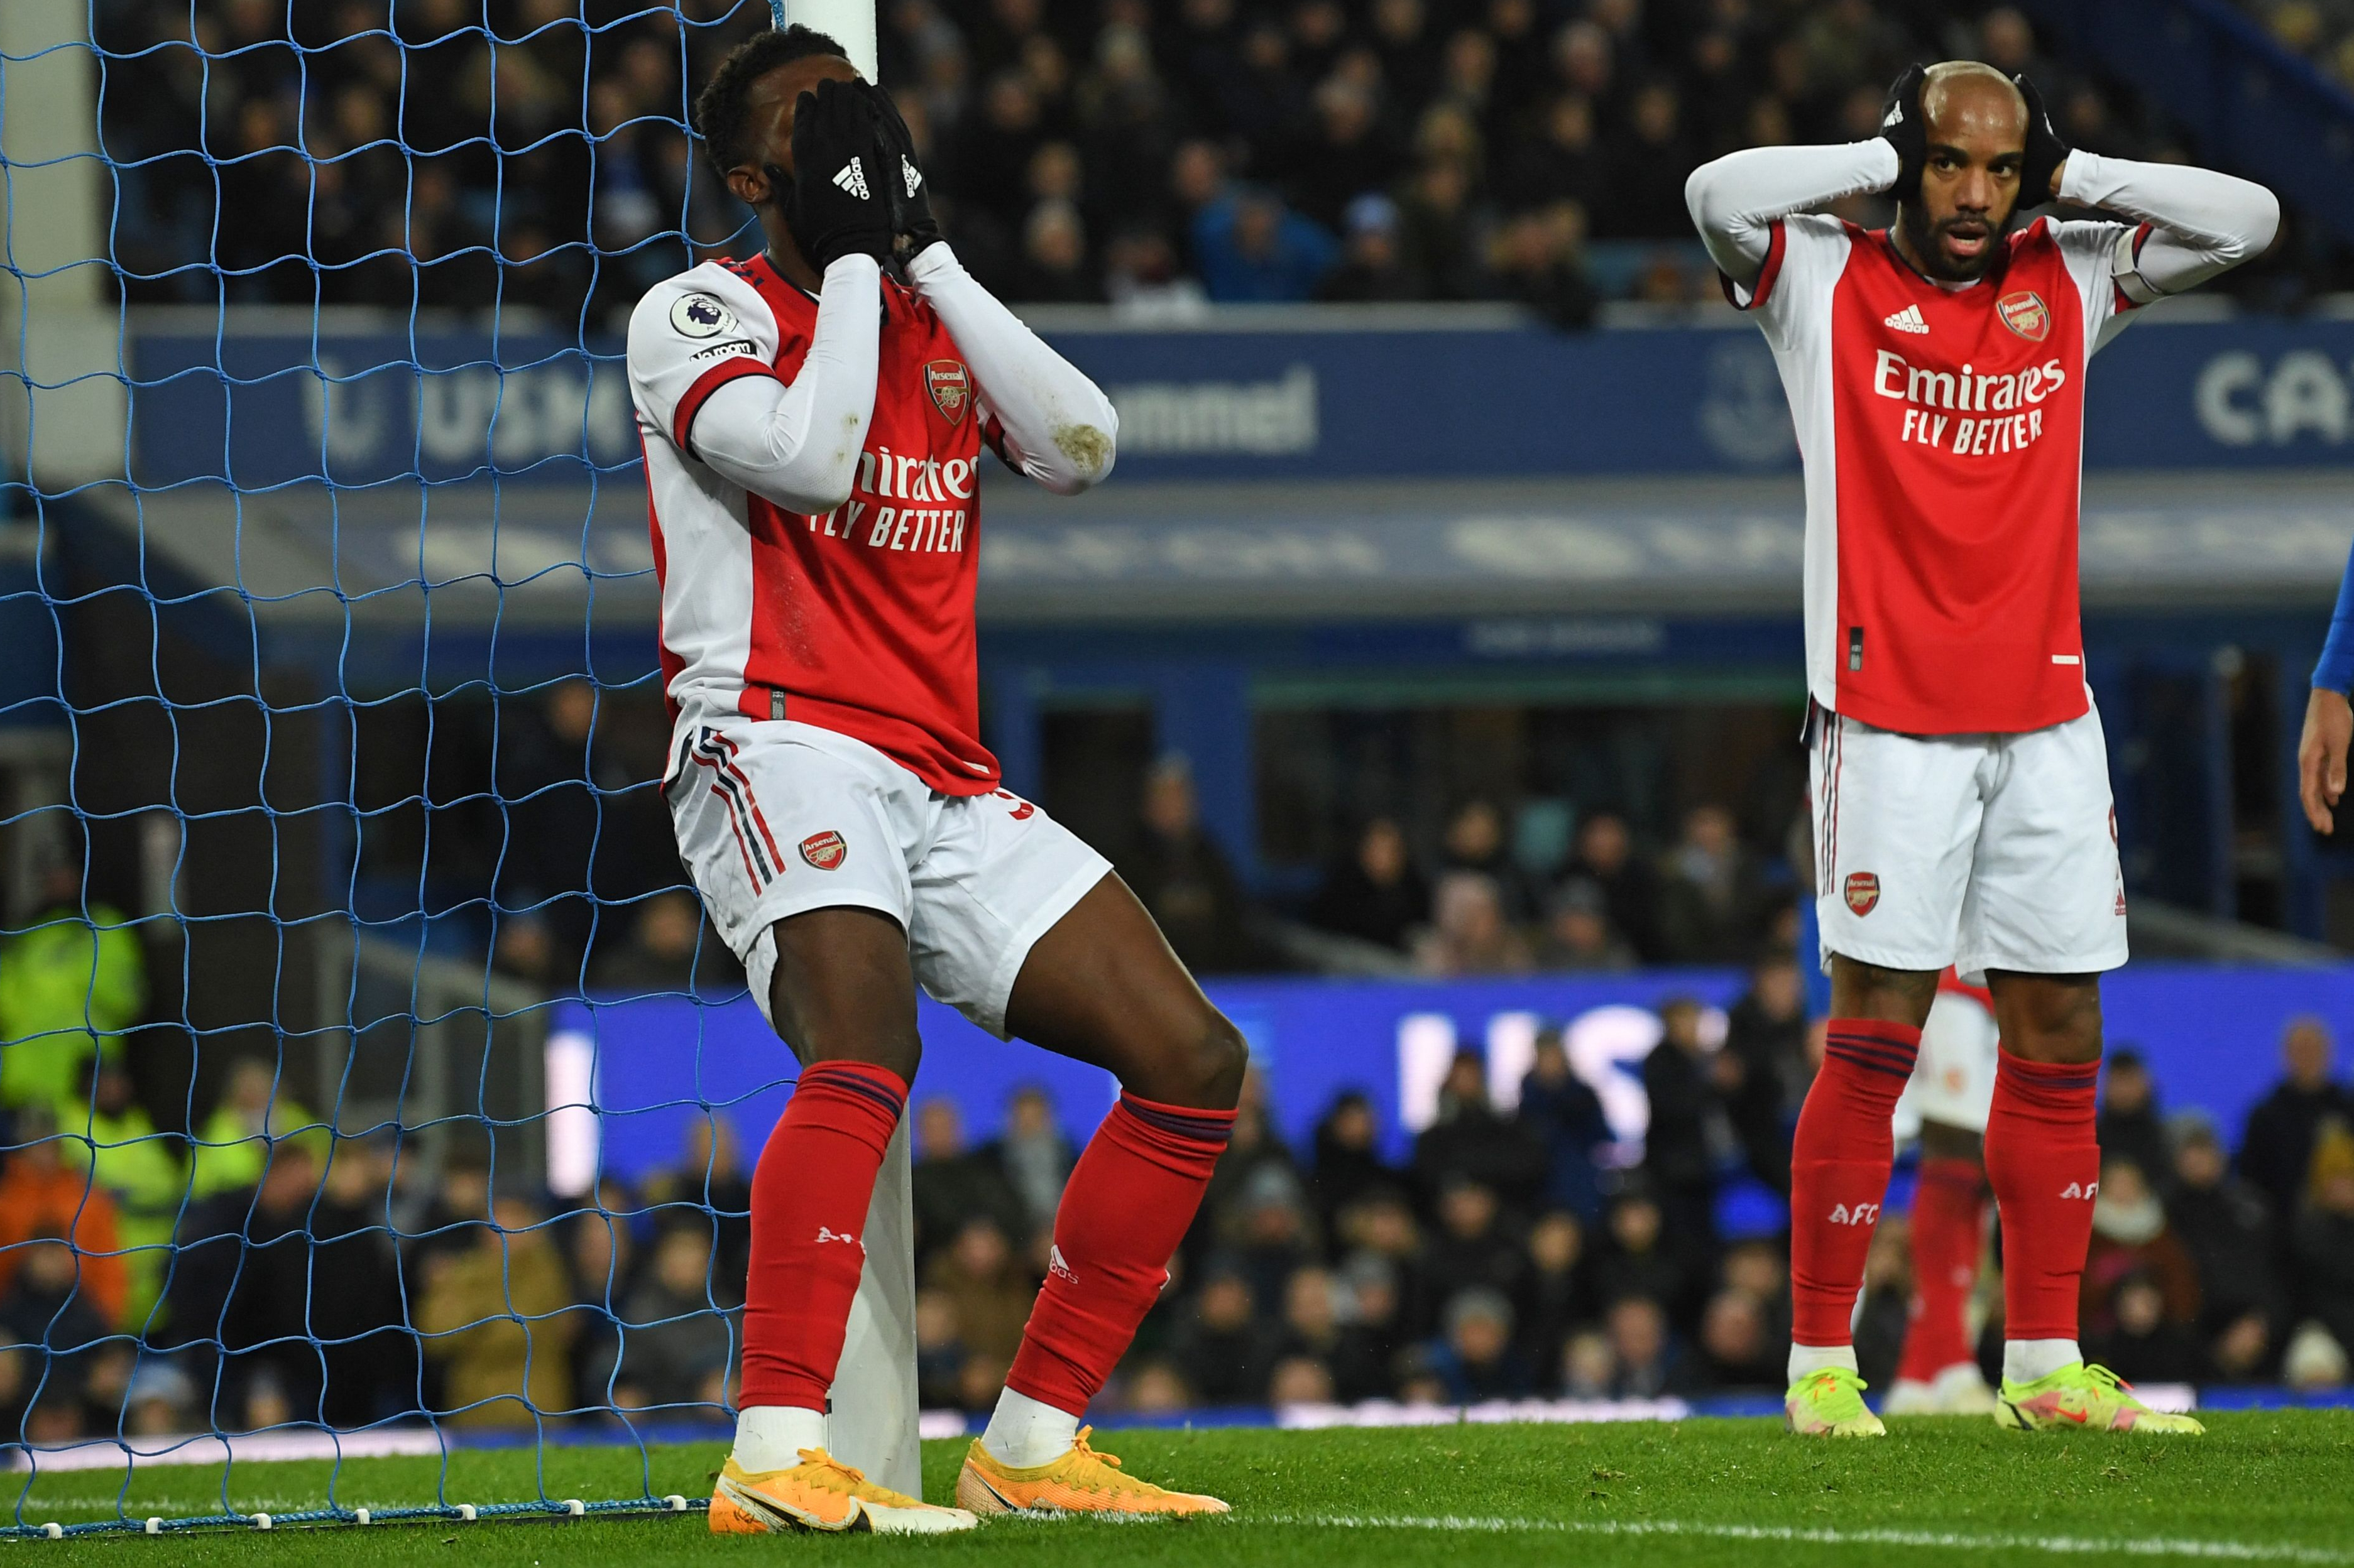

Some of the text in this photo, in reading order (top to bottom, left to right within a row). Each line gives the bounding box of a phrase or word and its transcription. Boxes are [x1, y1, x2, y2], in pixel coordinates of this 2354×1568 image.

[850, 156, 870, 200] adidas
[2005, 298, 2037, 315] Arsenal
[1884, 317, 1929, 334] adidas
[931, 370, 963, 380] Arsenal
[1875, 349, 2066, 411] Emirates
[2198, 349, 2354, 446] CA
[1902, 408, 2042, 455] FLY BETTER
[860, 446, 978, 502] irate
[868, 506, 965, 552] BETTER
[805, 835, 838, 852] Arsenal
[2060, 1182, 2099, 1200] AF
[1829, 1202, 1879, 1226] AFC
